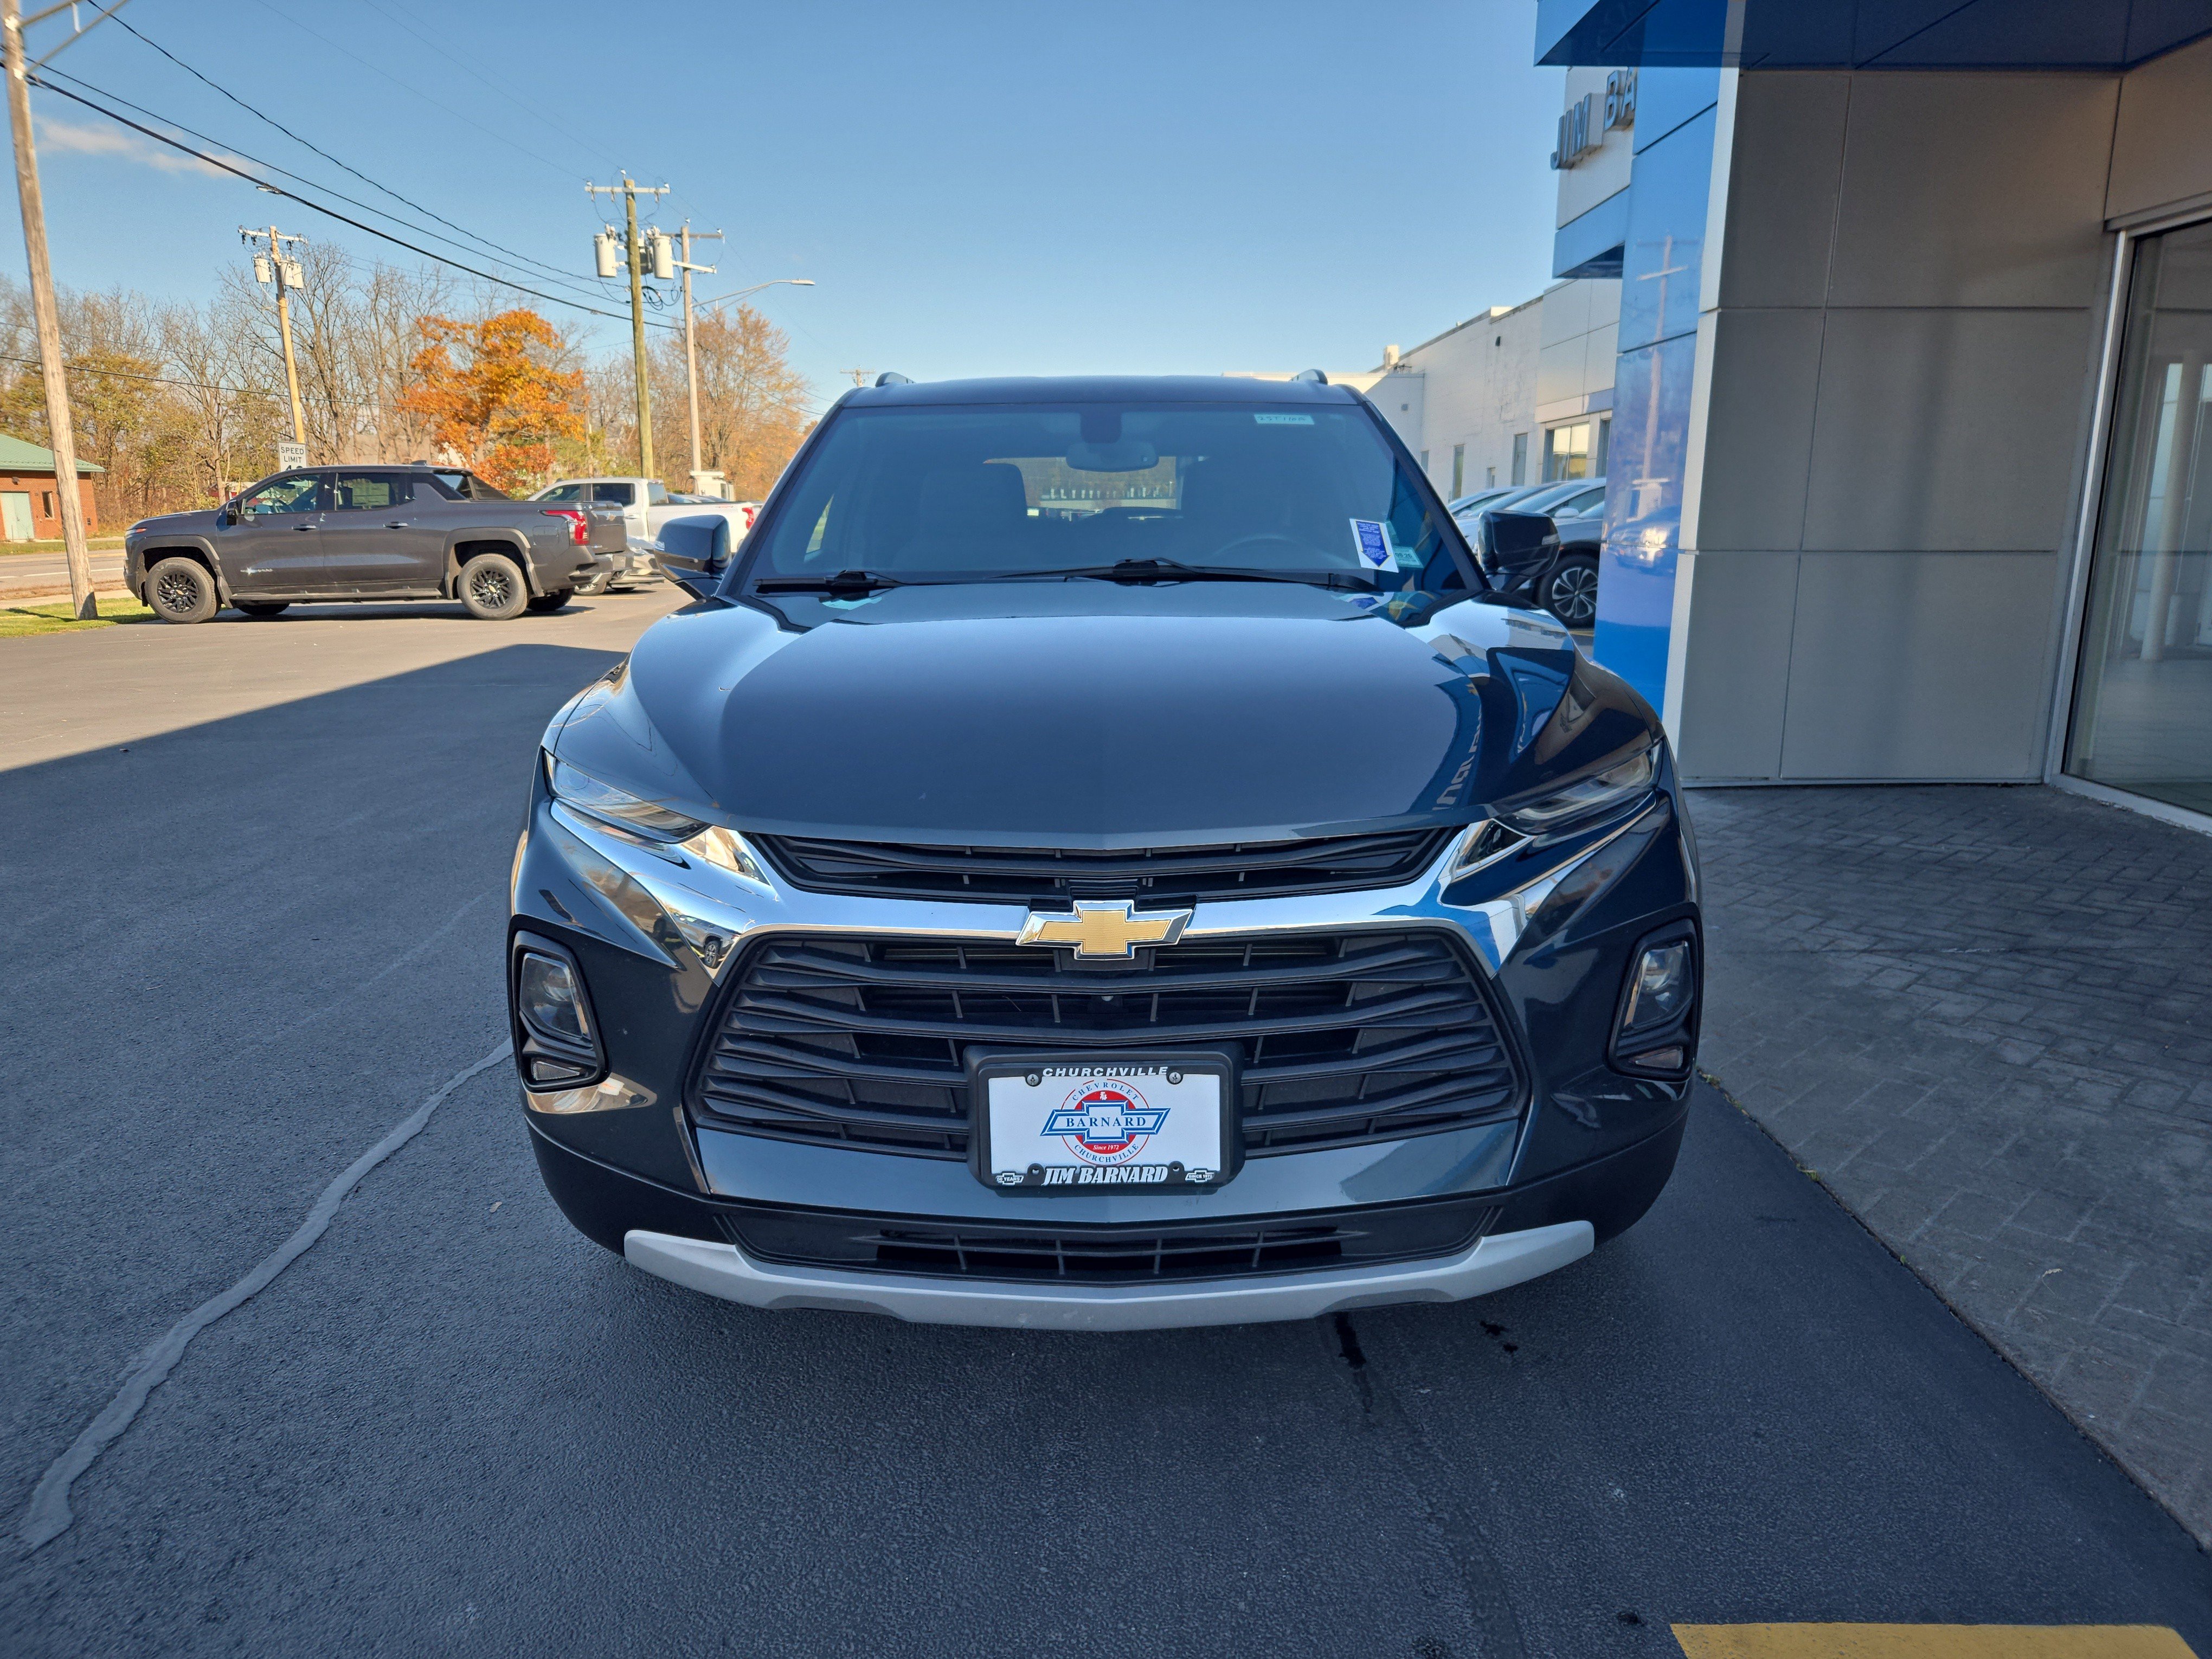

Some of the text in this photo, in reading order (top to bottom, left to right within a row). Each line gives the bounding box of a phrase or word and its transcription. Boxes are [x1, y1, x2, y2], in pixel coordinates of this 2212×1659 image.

[281, 447, 304, 455] SPEED
[1043, 1066, 1168, 1077] CHURCHVILLE
[1072, 1082, 1139, 1101] CHEVROLET
[1066, 1117, 1146, 1127] BARNARD
[1074, 1143, 1139, 1162] CHURCHVILLE
[1041, 1166, 1168, 1186] JIM BARNARD
